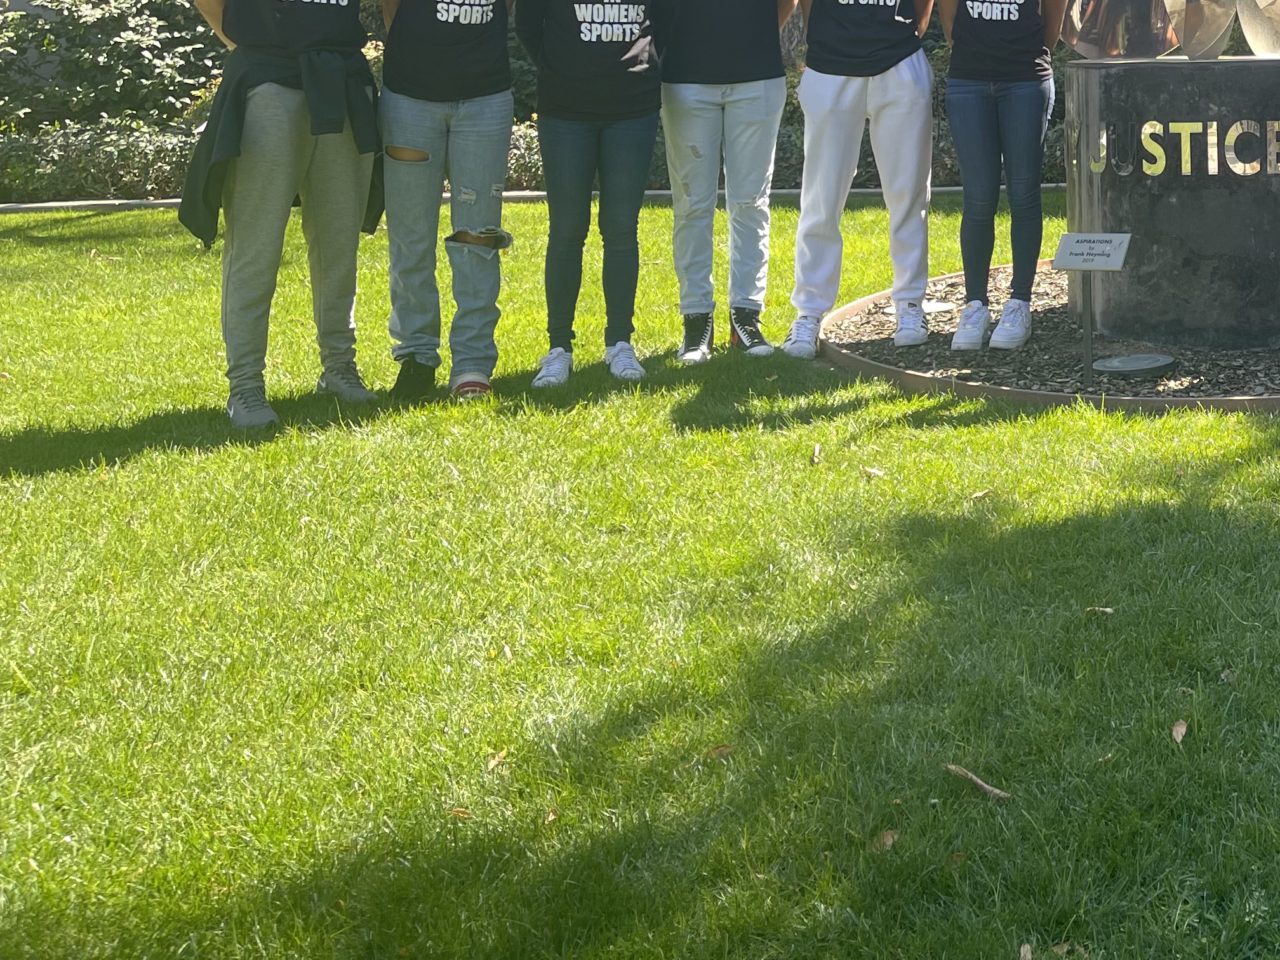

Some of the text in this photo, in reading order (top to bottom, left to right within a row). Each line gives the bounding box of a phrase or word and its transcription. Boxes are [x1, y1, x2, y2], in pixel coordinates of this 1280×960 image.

[436, 3, 494, 25] SPORTS
[574, 4, 645, 23] WOMENS
[966, 0, 1019, 21] SPORTS
[580, 22, 640, 42] SPORTS
